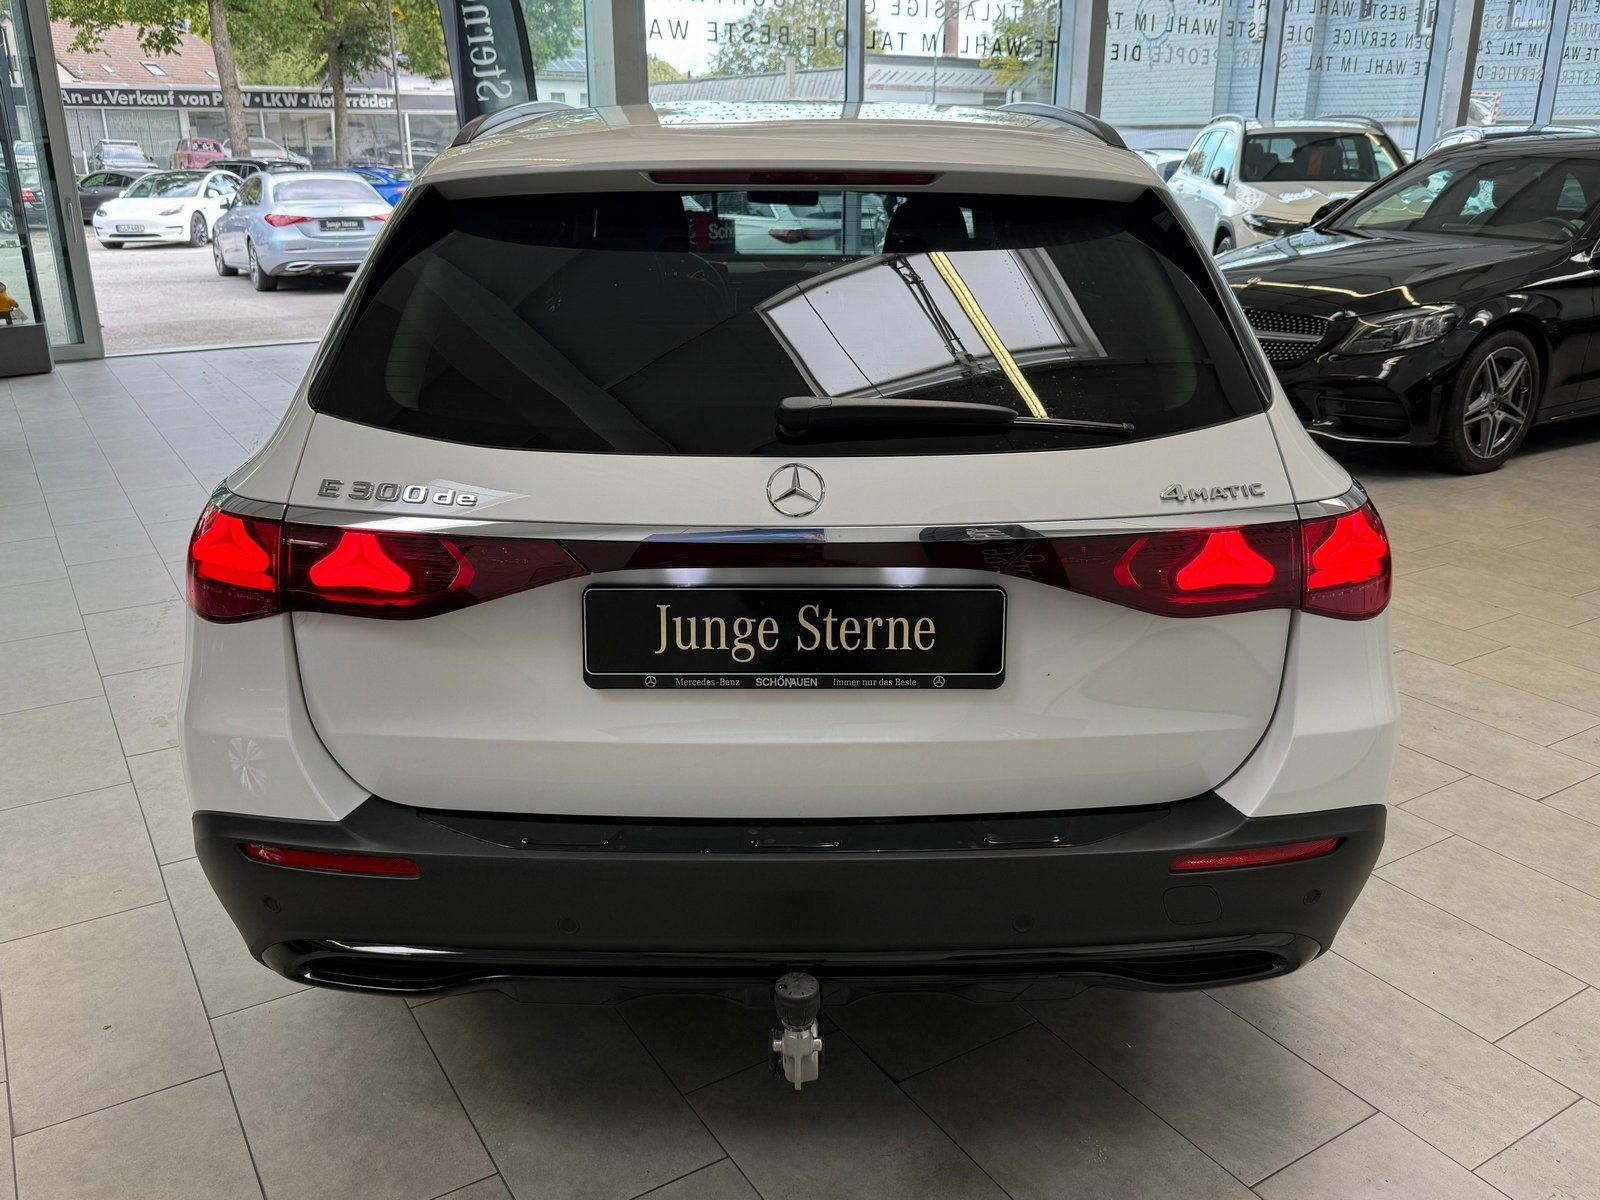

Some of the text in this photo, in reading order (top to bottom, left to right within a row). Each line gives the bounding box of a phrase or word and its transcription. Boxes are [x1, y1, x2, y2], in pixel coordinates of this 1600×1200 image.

[178, 94, 210, 106] von
[212, 92, 251, 107] PW
[263, 93, 300, 107] LKW
[317, 478, 478, 507] E 300 de
[1160, 483, 1265, 502] 4MATIC
[655, 604, 936, 663] Junge Sterne
[675, 678, 740, 686] Mercedes-Benz
[833, 678, 860, 686] Immer
[878, 678, 893, 686] das
[895, 678, 917, 686] Beste
